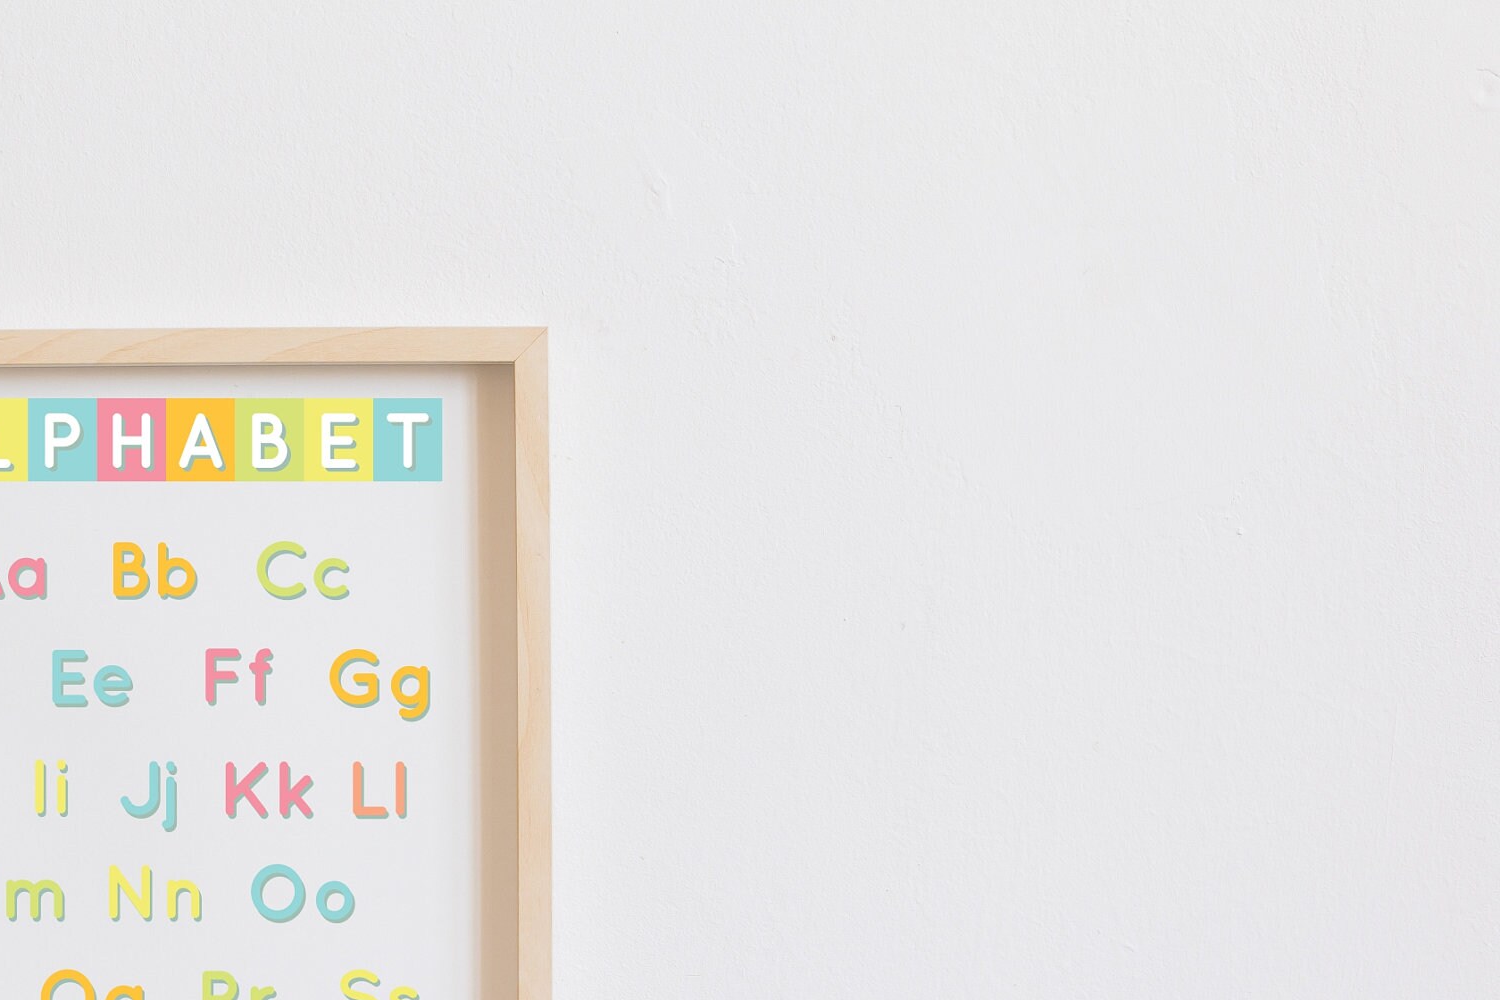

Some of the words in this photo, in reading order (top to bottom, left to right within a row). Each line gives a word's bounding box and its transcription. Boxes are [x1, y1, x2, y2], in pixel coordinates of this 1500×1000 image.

[112, 541, 197, 599] Bb
[256, 541, 350, 599] Cc
[52, 649, 133, 707] Ee
[205, 648, 273, 705] Ff
[329, 648, 431, 721] Gg
[34, 759, 69, 816] Ii
[120, 761, 178, 831] Jj
[225, 761, 314, 818] Kk
[352, 761, 407, 818] Ll
[108, 864, 203, 921] Nn
[251, 864, 355, 922] Oo
